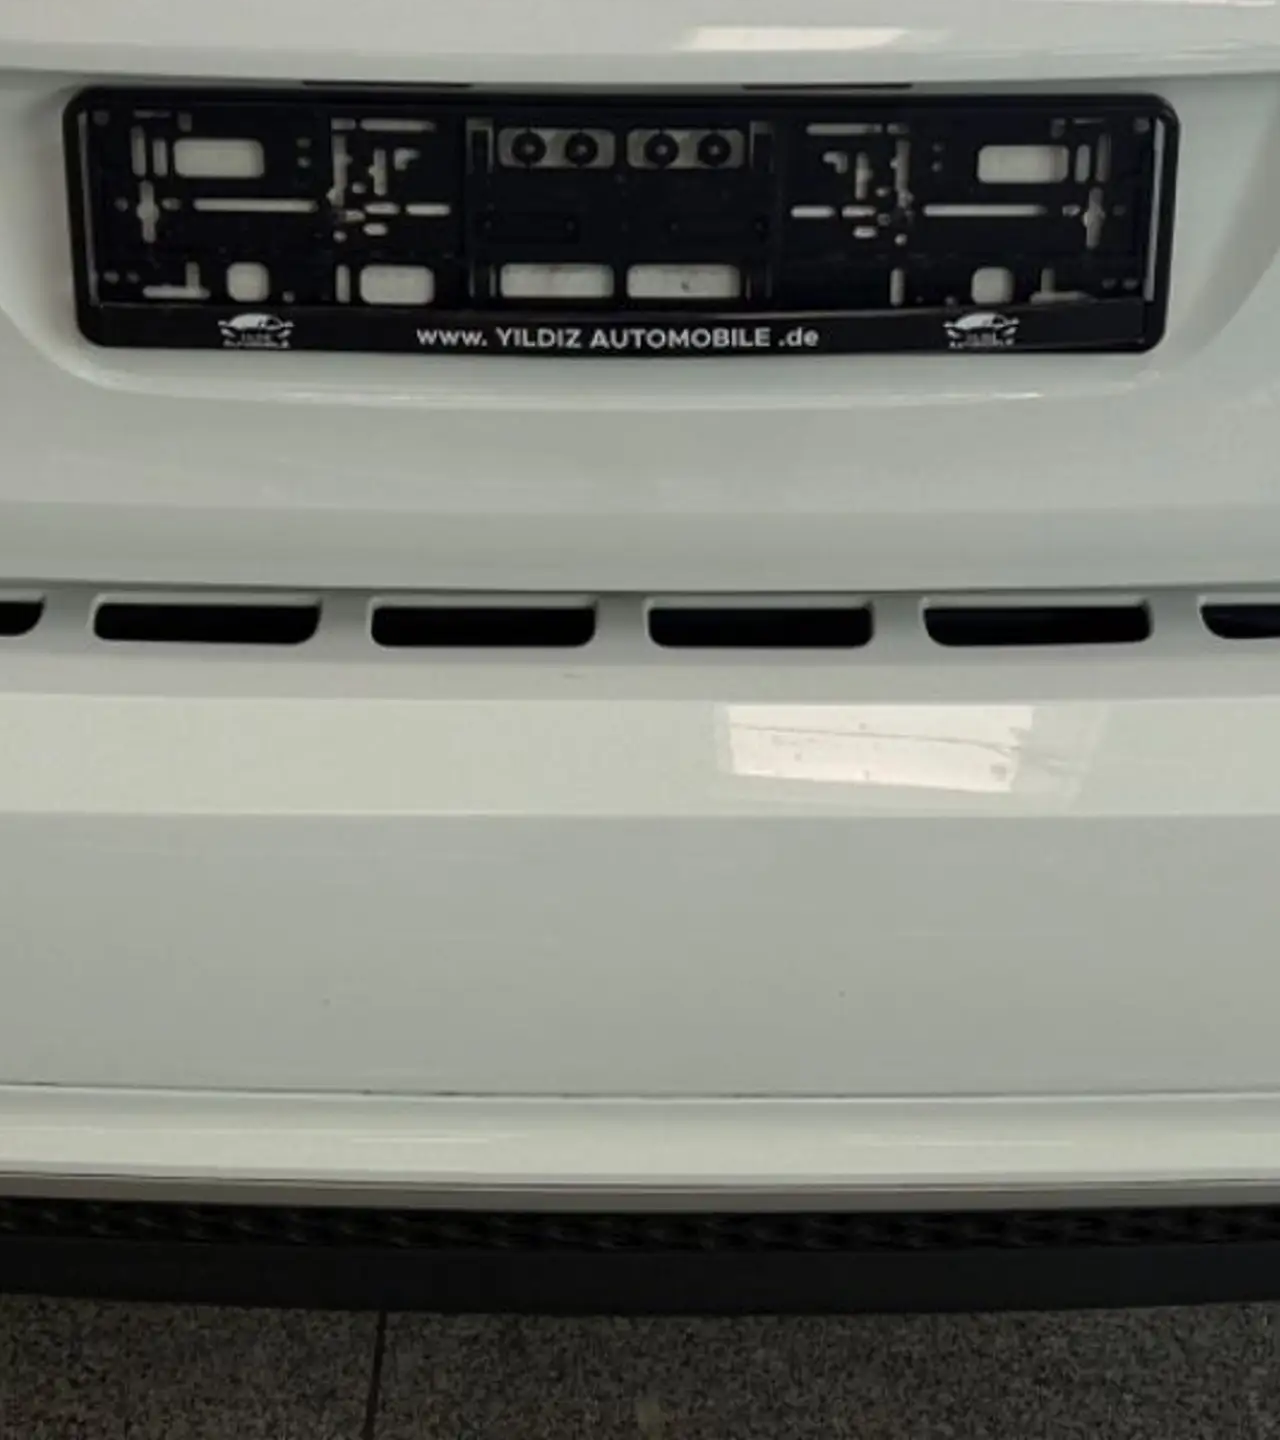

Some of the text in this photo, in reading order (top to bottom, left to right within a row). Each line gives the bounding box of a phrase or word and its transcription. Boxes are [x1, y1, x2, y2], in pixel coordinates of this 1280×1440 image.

[416, 326, 819, 350] www. YILDIZ AUTOMOBILE .de
